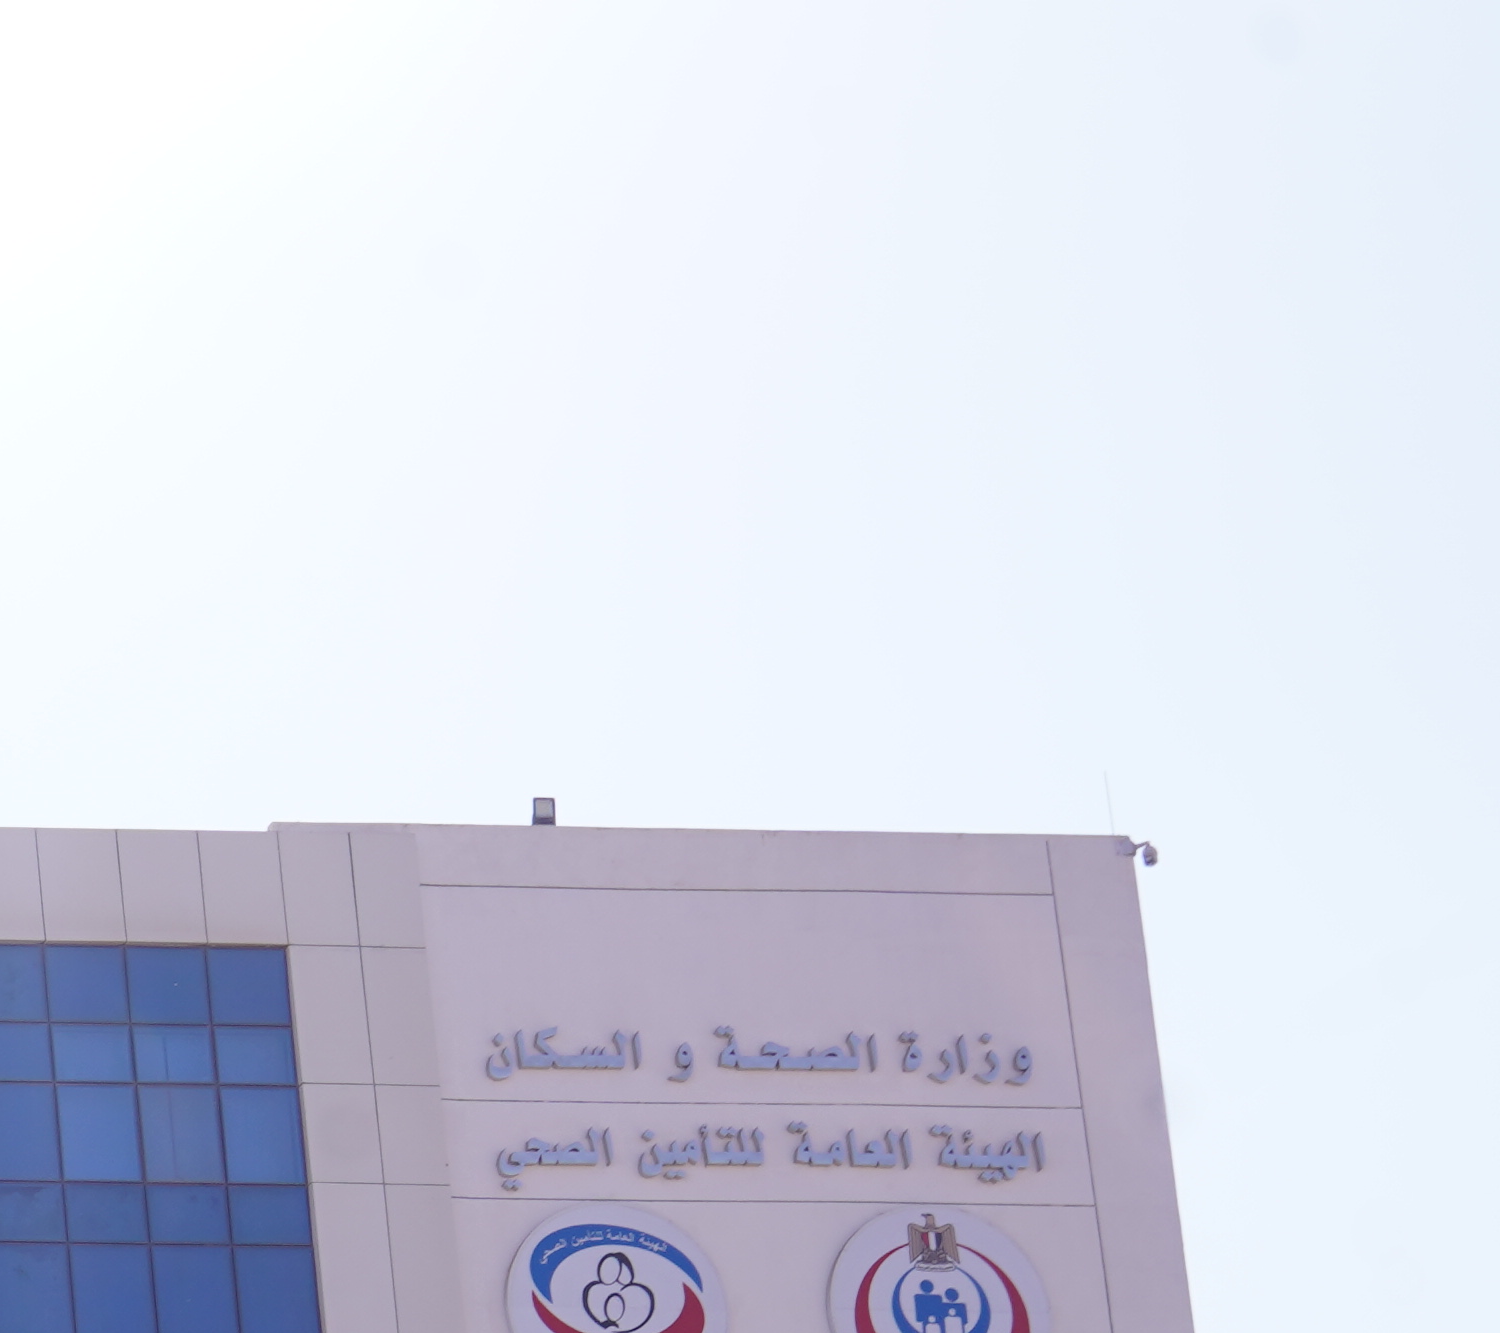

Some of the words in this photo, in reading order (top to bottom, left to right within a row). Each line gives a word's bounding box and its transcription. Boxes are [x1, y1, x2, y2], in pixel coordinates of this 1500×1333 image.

[485, 1026, 643, 1081] السكان
[713, 1026, 877, 1073] الصحة
[897, 1030, 1033, 1086] وزارة
[496, 1126, 613, 1191] الصحي
[637, 1123, 764, 1179] للتأمين
[786, 1120, 913, 1170] العامة
[928, 1123, 1045, 1184] الهيئة
